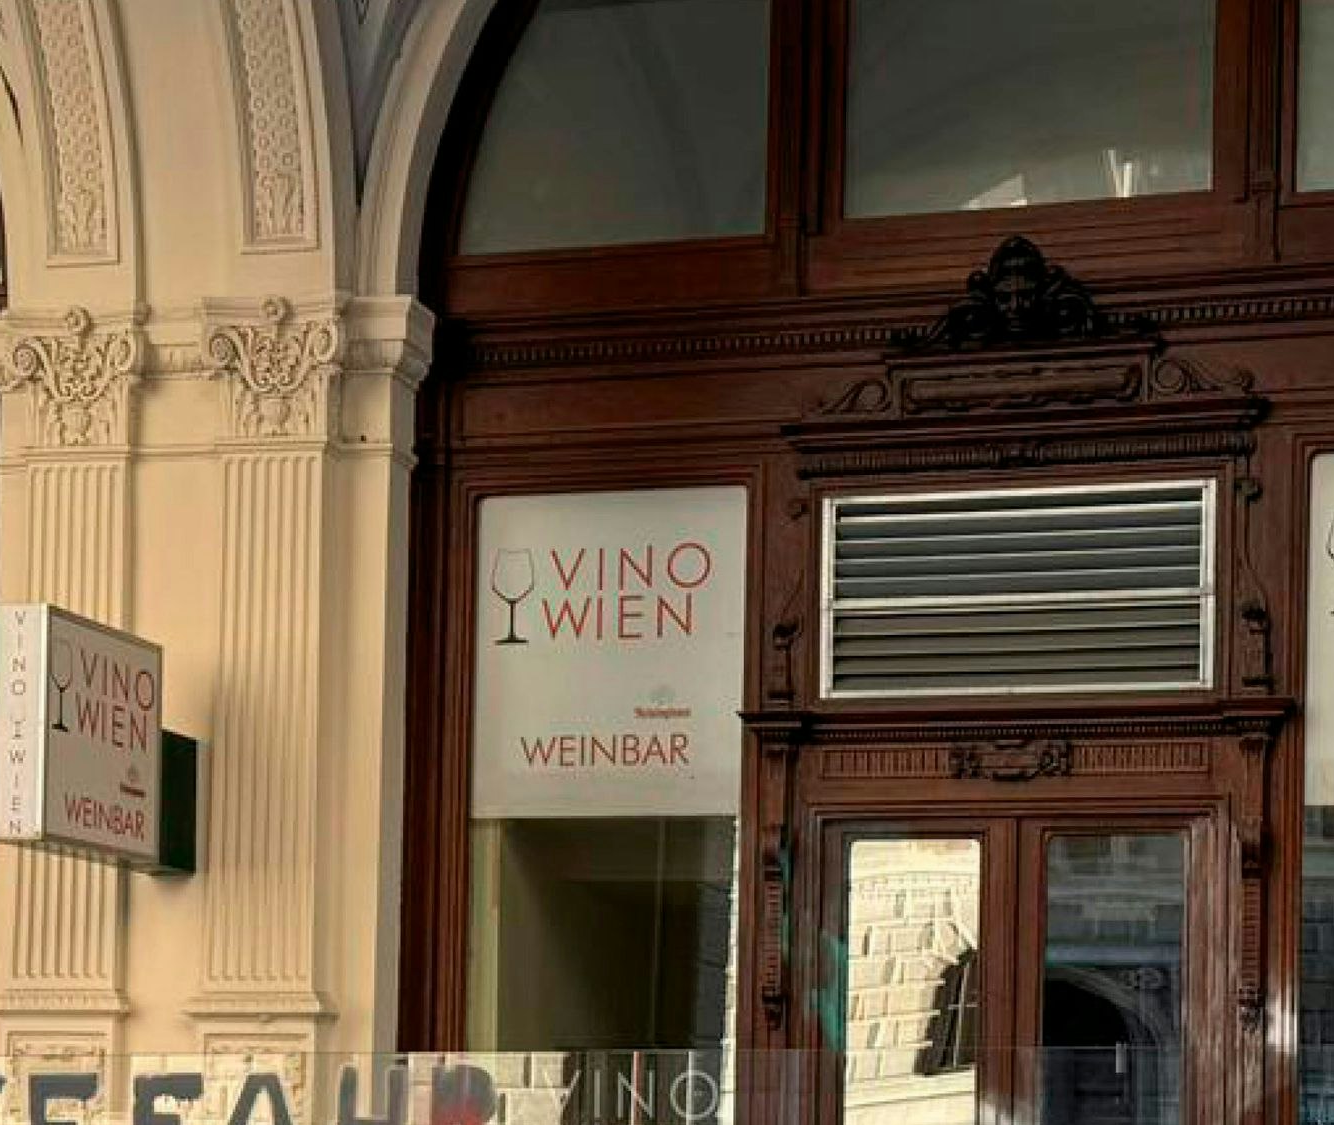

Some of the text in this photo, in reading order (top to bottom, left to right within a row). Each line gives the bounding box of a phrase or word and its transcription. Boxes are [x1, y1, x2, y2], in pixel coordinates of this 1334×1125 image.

[551, 541, 712, 591] VINO
[540, 592, 693, 641] WIEN
[79, 649, 155, 712] VINO
[9, 610, 27, 836] VINO WIEN
[75, 692, 148, 752] WIEN
[519, 733, 690, 768] WEINBAR
[63, 791, 146, 842] WEINBAR
[542, 1069, 718, 1121] VINO
